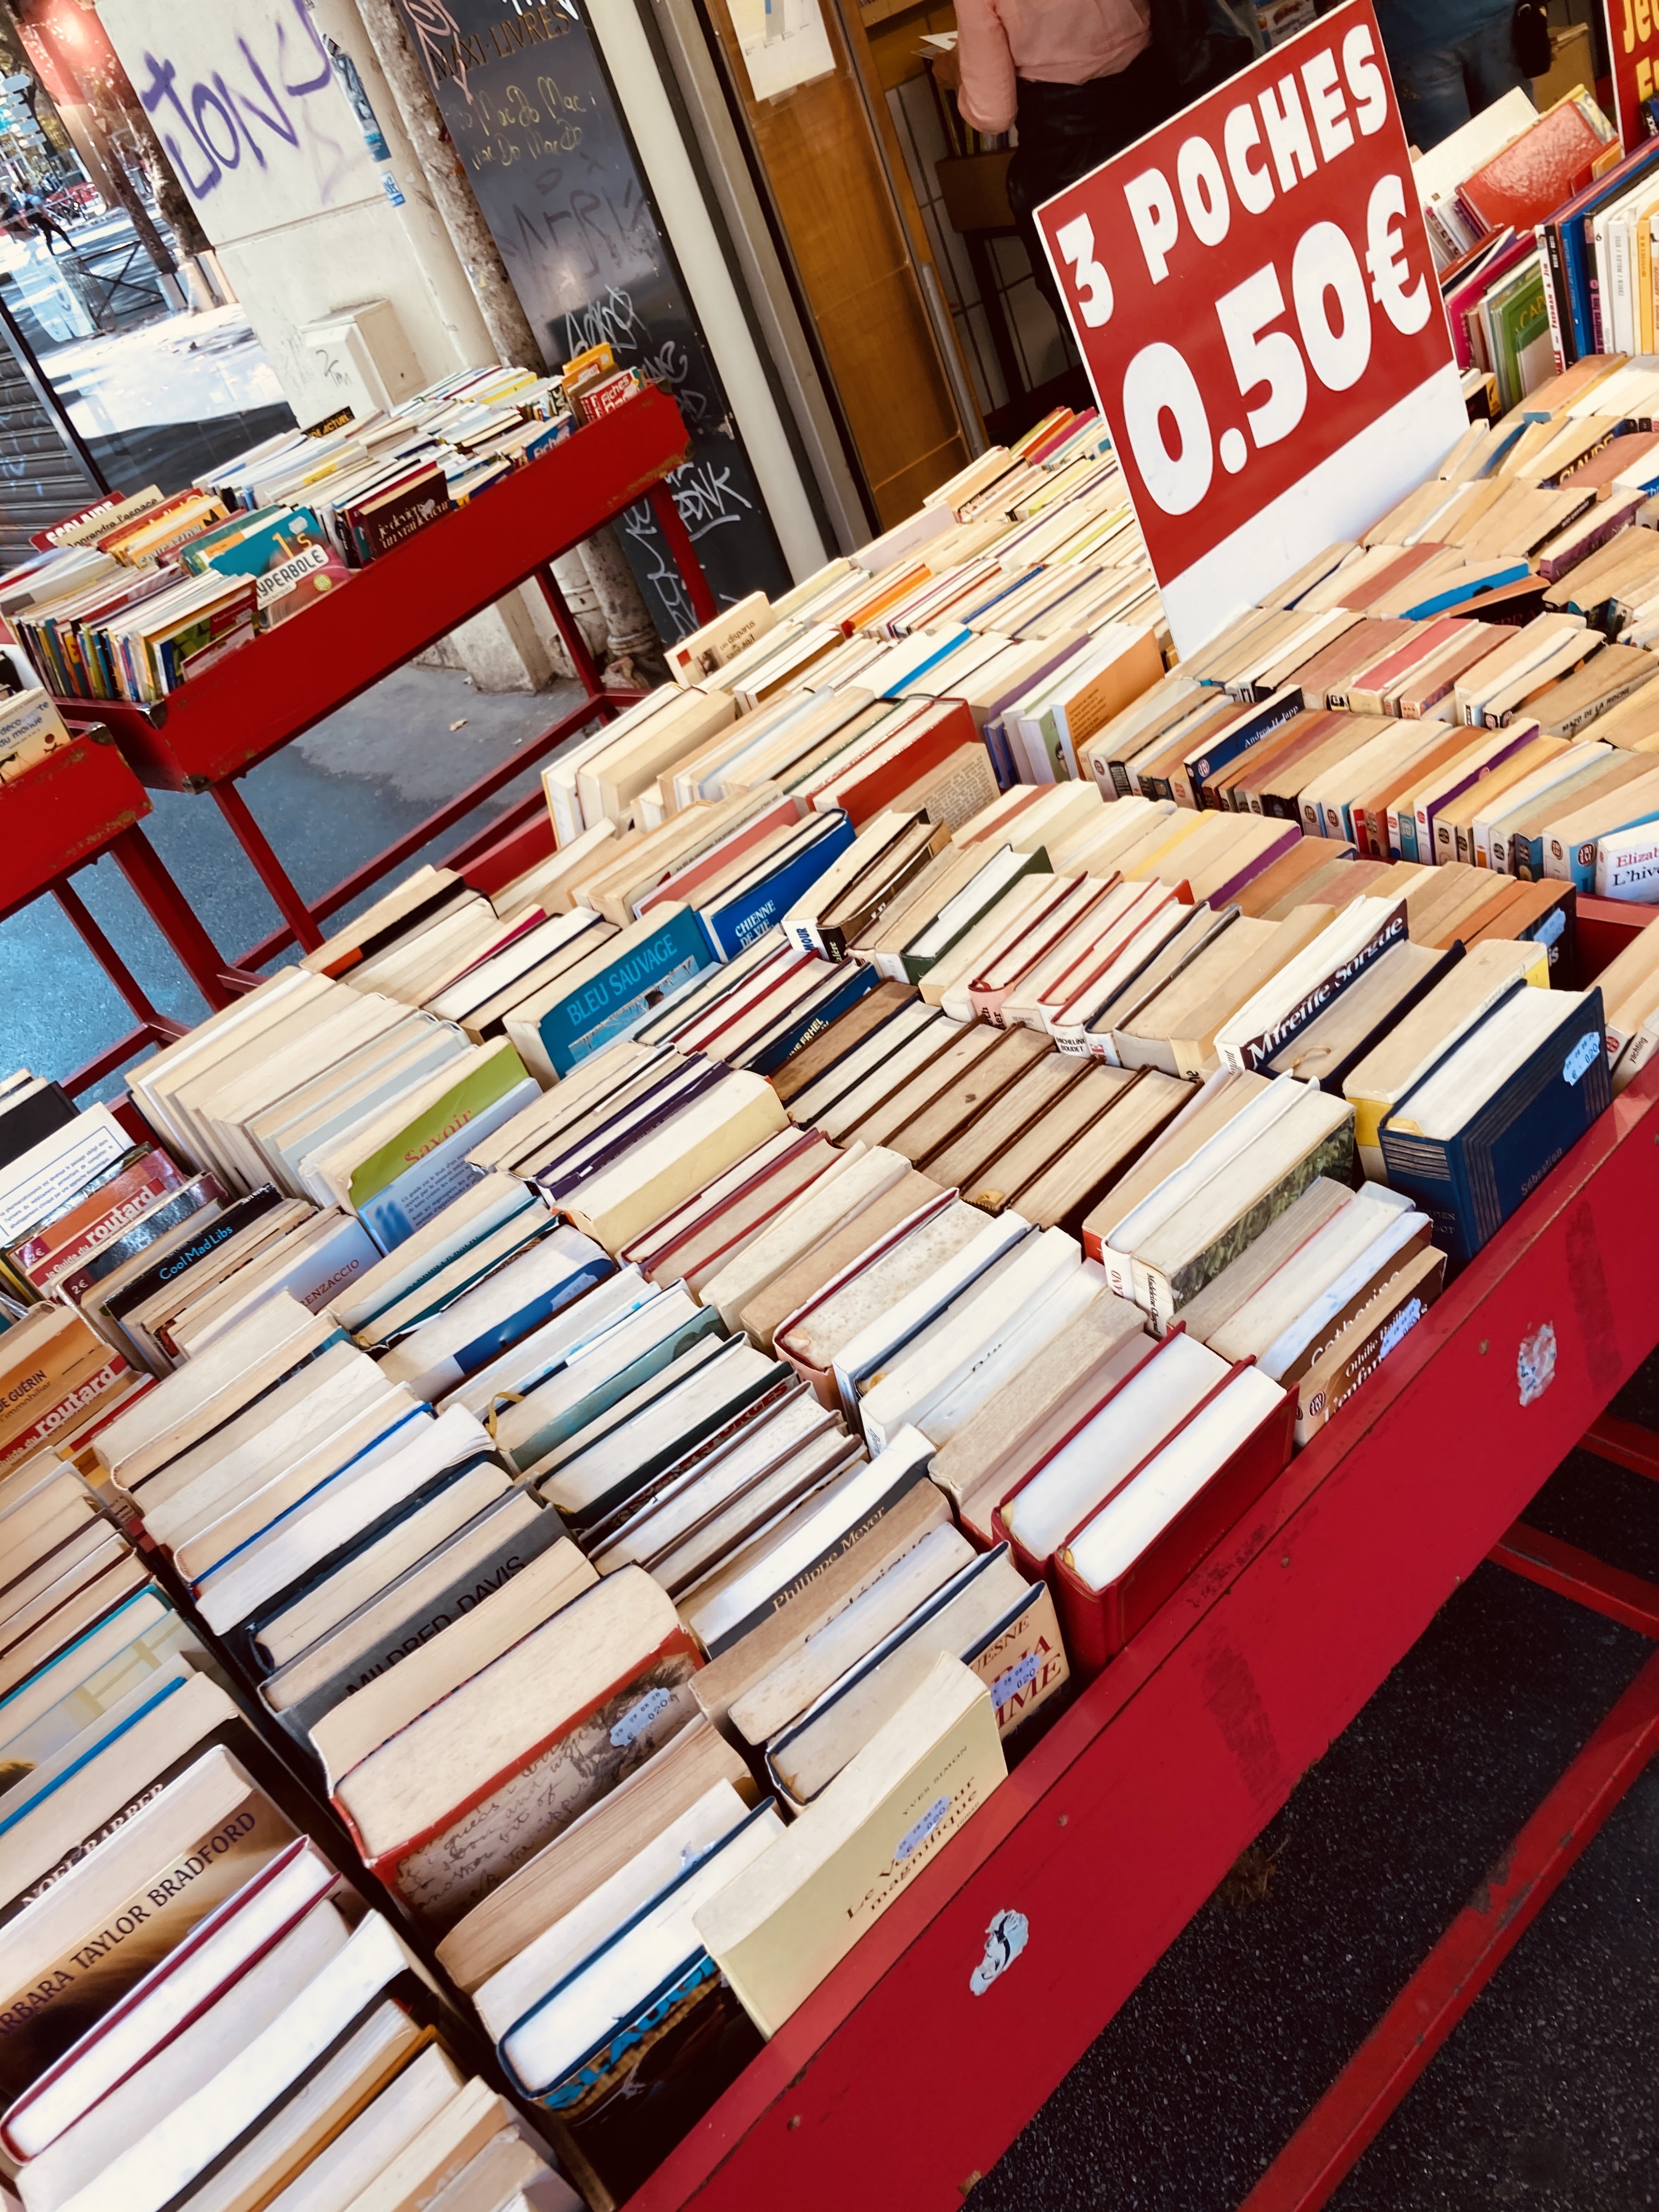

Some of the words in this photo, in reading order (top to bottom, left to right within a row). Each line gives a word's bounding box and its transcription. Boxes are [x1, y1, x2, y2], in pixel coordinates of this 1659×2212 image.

[1056, 212, 1114, 328] 3
[1124, 24, 1388, 285] POCHES
[1122, 174, 1431, 515] 0.50€
[601, 375, 631, 404] Fiches
[727, 619, 756, 645] disparus
[735, 899, 776, 938] CHIENNE
[740, 935, 754, 950] DE
[566, 982, 610, 1026] BLEU
[608, 933, 678, 997] SAUVAGE
[1629, 1036, 1649, 1064] yachting
[404, 1109, 472, 1163] Savoir
[84, 1185, 157, 1248] routard
[53, 1252, 79, 1274] Guide
[78, 1244, 91, 1257] du
[159, 1256, 188, 1280] Cool
[184, 1238, 212, 1263] Mad
[209, 1225, 234, 1245] Libs
[71, 1278, 89, 1295] 2€
[9, 1369, 48, 1402] GUÉRIN
[0, 1447, 25, 1468] uide
[35, 1364, 116, 1439] routard
[772, 1552, 838, 1611] Philippe
[840, 1506, 885, 1551] Meyer
[346, 1613, 452, 1695] MILDRED
[456, 1555, 527, 1615] DAVIS
[1016, 1667, 1036, 1689] 020
[902, 1786, 930, 1816] YVES
[933, 1745, 968, 1785] SIMON
[870, 1790, 978, 1911] magnifique
[1, 1970, 75, 2030] RBARA
[70, 1906, 151, 1972] TAYLOR
[148, 1811, 256, 1908] BRADFORD
[844, 1888, 875, 1920] Le
